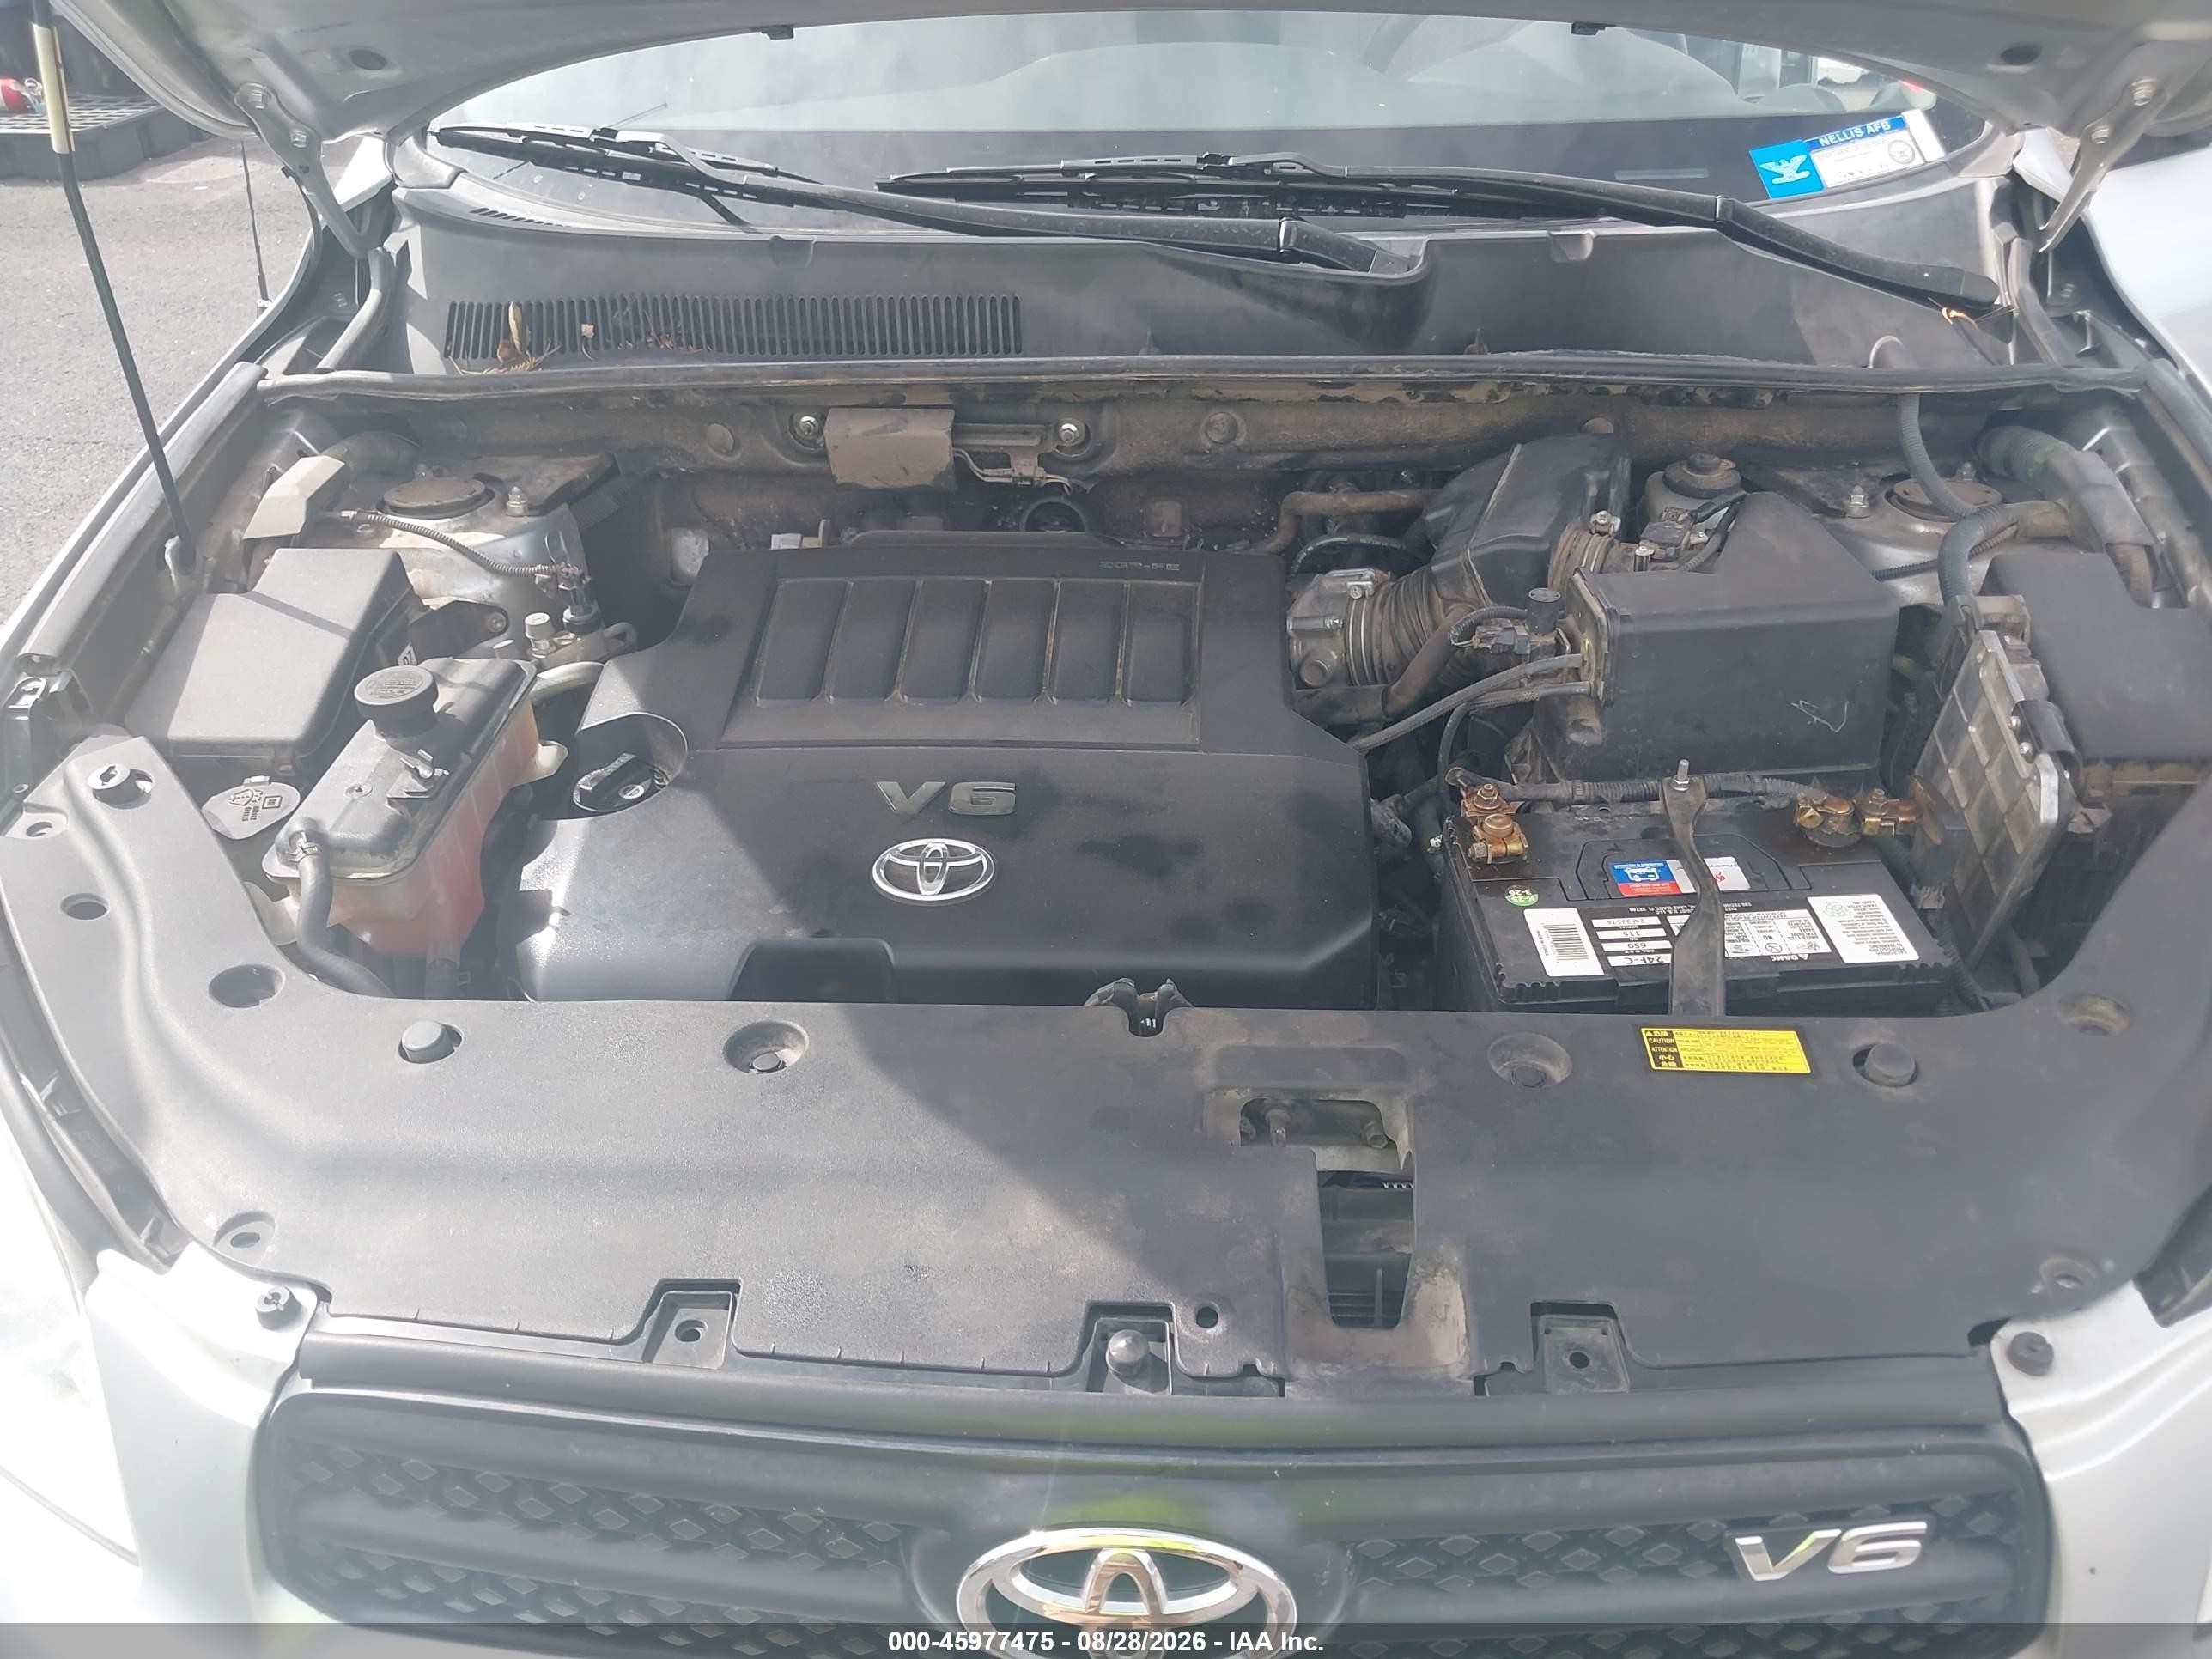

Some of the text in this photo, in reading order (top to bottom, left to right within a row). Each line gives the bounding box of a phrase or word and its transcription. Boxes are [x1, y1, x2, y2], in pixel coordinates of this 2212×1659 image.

[1818, 120, 1891, 147] NELLIS AFB
[874, 781, 1016, 816] V6
[1624, 956, 1664, 964] 24F-C
[1735, 1521, 1928, 1581] V6
